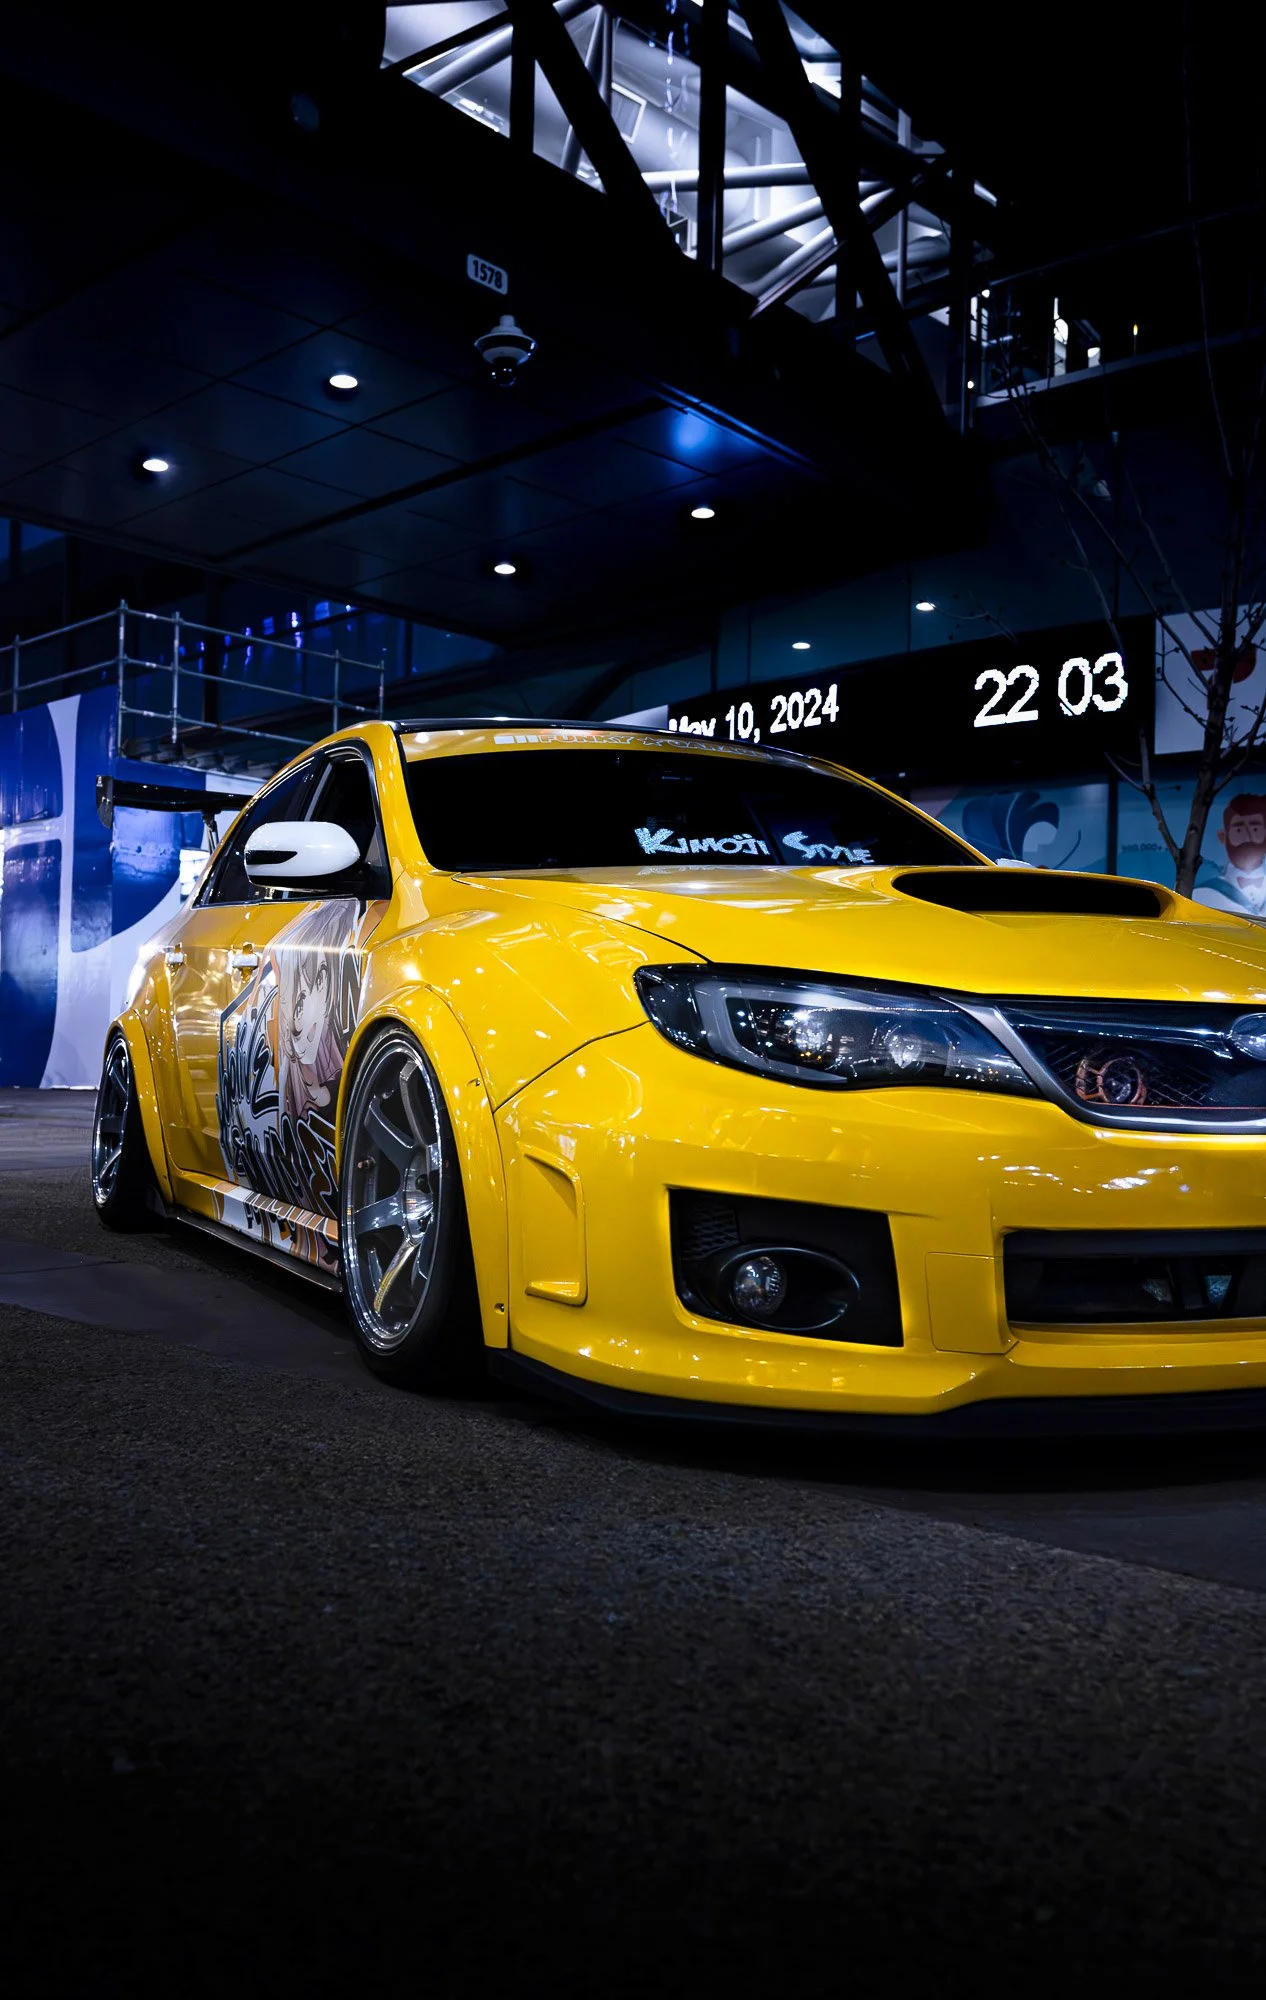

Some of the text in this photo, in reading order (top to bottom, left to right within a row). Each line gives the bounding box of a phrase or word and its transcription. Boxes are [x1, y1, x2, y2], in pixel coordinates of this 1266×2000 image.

[472, 259, 503, 289] 1578
[725, 701, 760, 744] 10,
[769, 683, 840, 734] 2024
[974, 652, 1129, 728] 22 03
